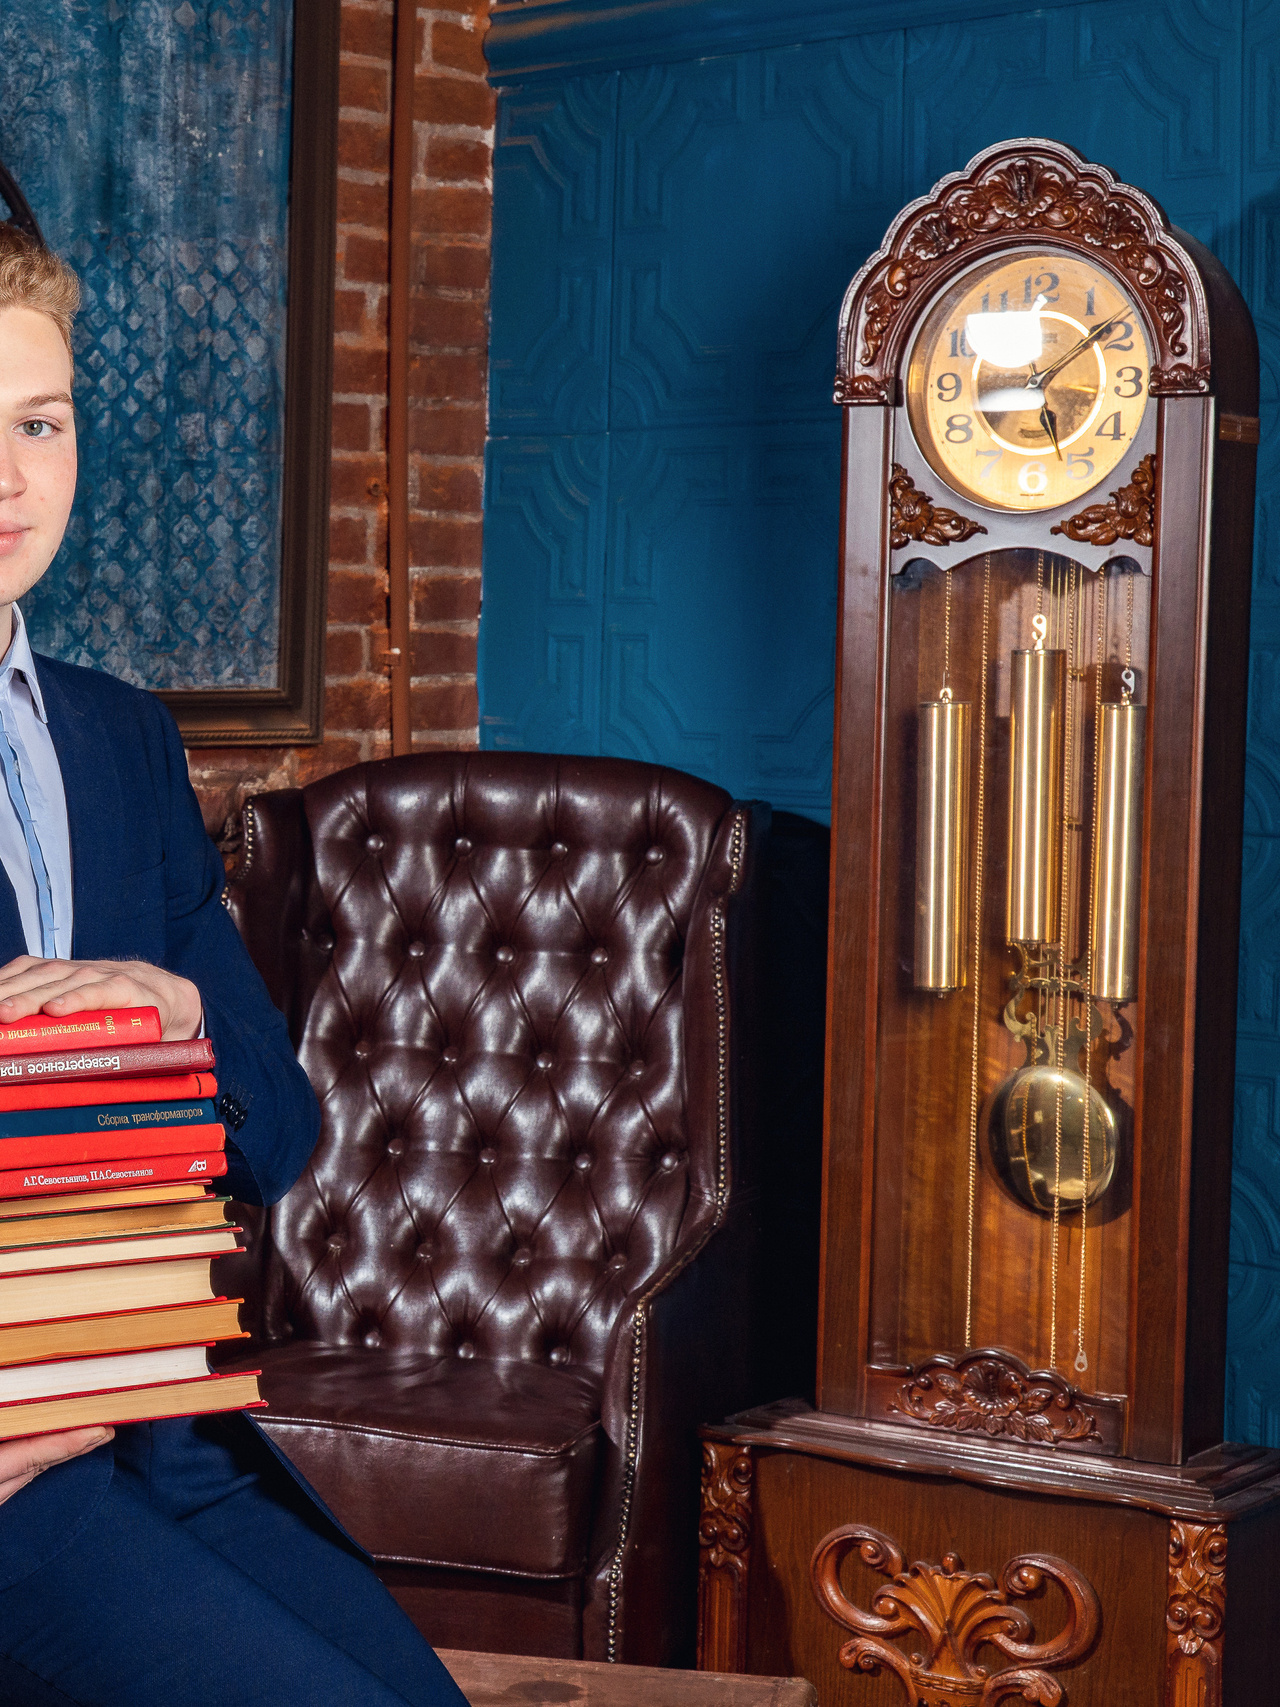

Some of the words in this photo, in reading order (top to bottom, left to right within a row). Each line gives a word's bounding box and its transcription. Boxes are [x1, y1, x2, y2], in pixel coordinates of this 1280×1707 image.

[1023, 272, 1061, 304] 12
[1084, 287, 1096, 317] 1
[1103, 321, 1135, 351] 2
[936, 372, 963, 402] 9
[1113, 366, 1144, 398] 3
[945, 414, 974, 444] 8
[1094, 410, 1127, 441] 4
[975, 447, 1004, 478] 7
[1016, 460, 1049, 494] 6
[1065, 446, 1096, 480] 5
[6, 1028, 37, 1039] ТРЕТИЙ
[39, 1021, 100, 1036] ВНЕОЧЕРЕДНОЙ
[103, 1014, 116, 1035] 1990
[26, 1053, 120, 1076] Безверетенное
[97, 1111, 130, 1127] Сборка
[131, 1106, 204, 1124] трансформаторов
[23, 1172, 89, 1186] А.Г.Севостьянов,
[89, 1166, 153, 1180] П.А.Севостьянов
